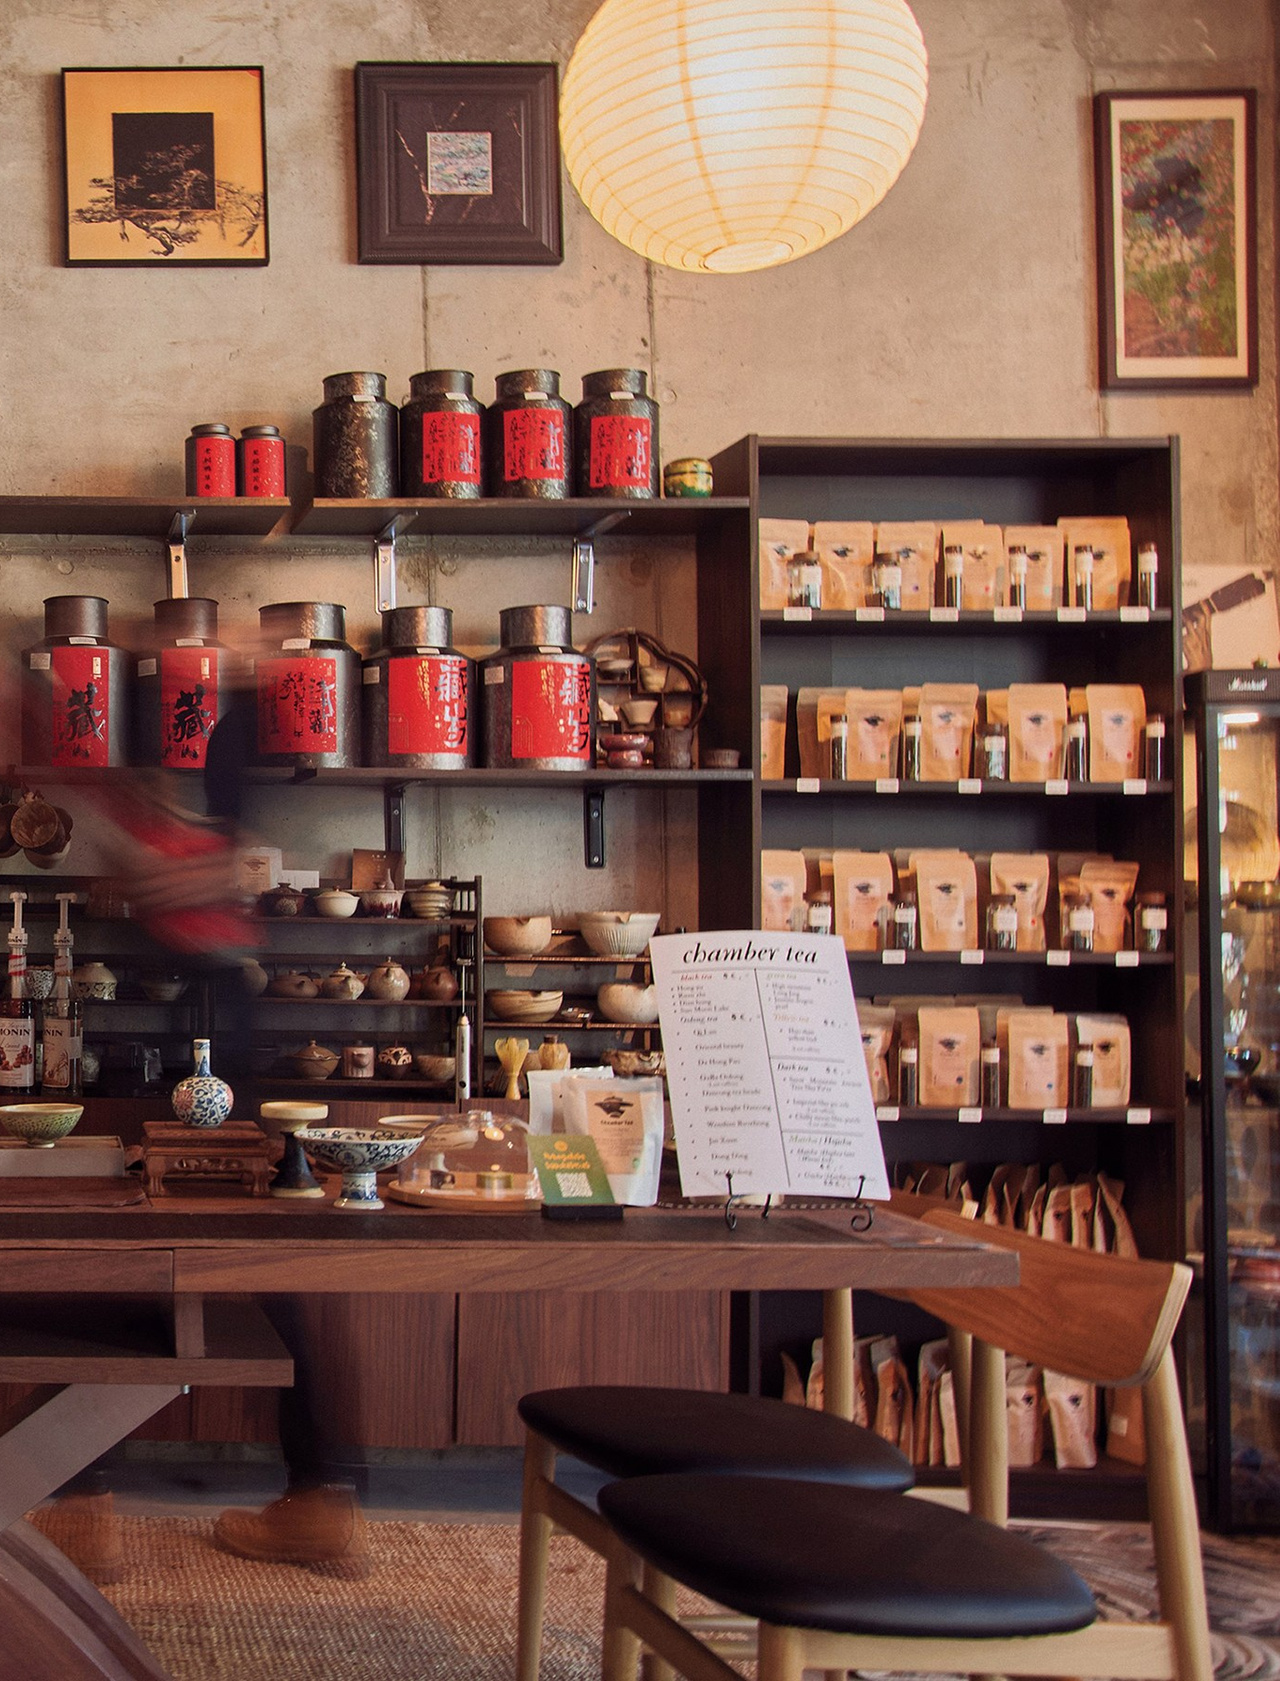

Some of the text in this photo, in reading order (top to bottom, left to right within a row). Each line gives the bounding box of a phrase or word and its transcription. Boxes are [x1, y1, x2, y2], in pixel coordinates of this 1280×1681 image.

[683, 941, 818, 963] chamber tea
[777, 1063, 796, 1071] Dark
